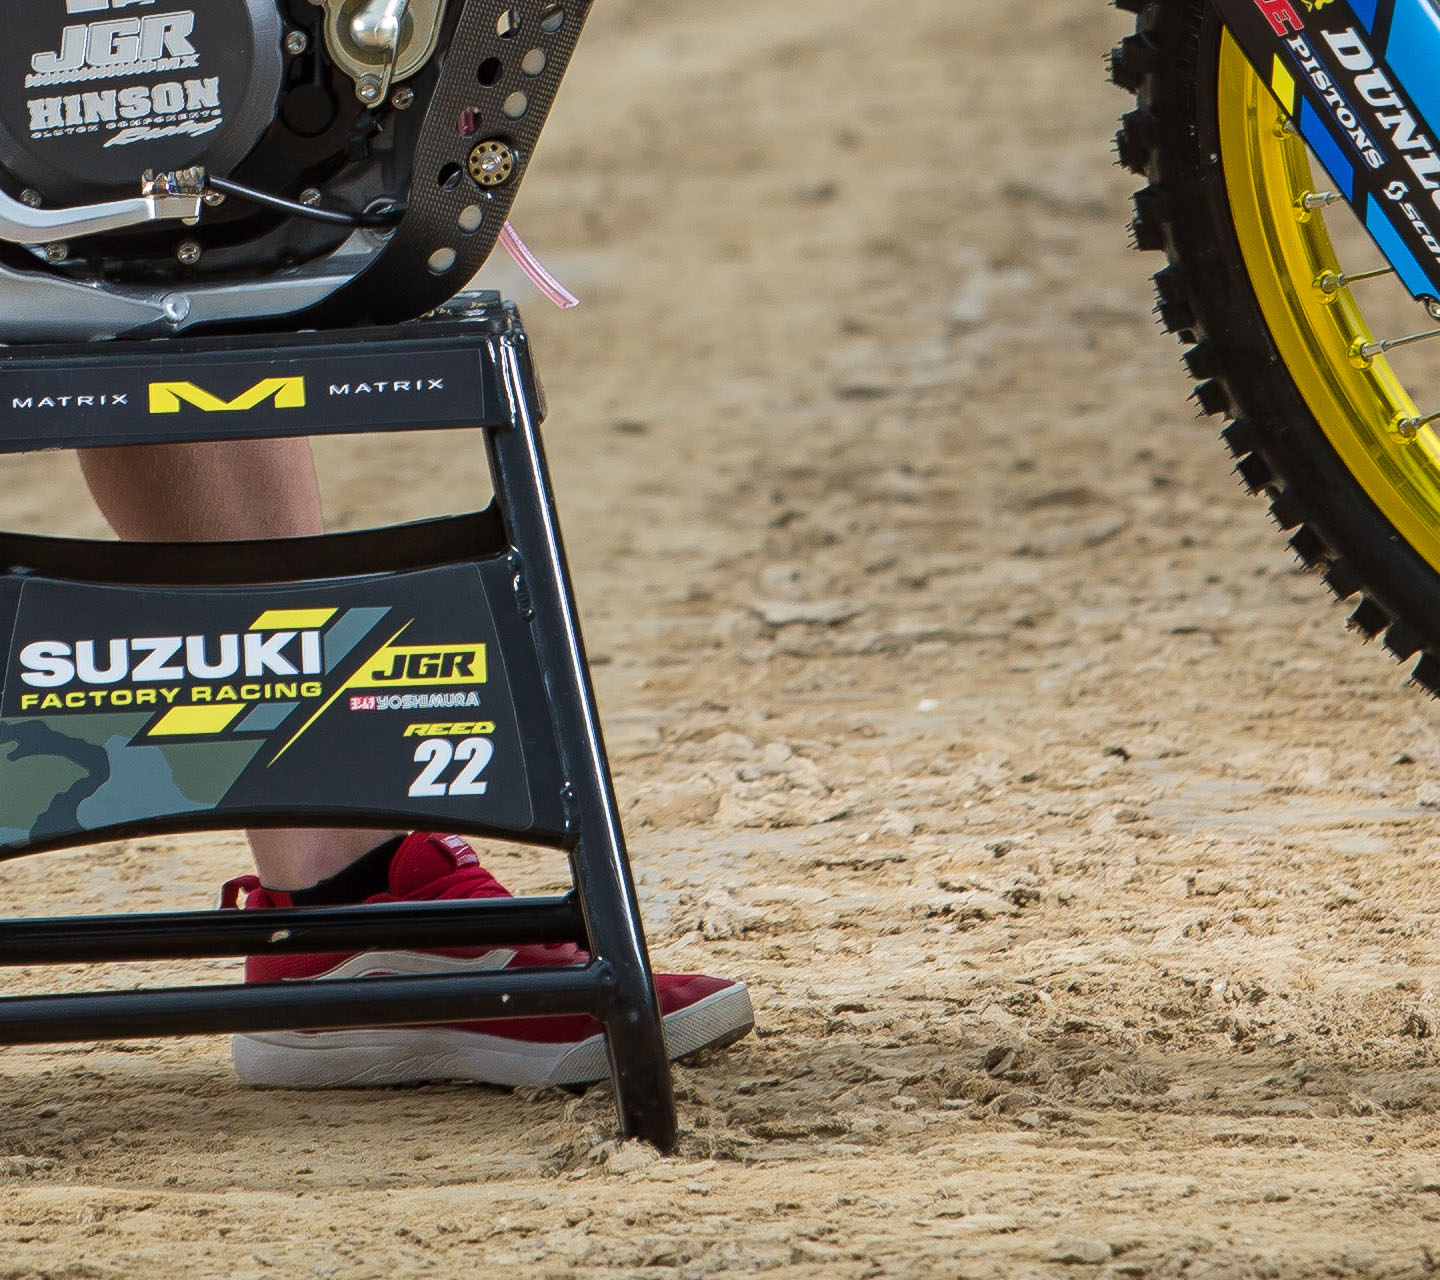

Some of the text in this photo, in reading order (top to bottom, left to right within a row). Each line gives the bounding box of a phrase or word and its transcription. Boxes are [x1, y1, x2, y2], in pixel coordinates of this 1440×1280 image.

[31, 10, 197, 73] JGR
[27, 76, 220, 130] HINSON
[1287, 34, 1385, 169] PISTONS
[12, 393, 128, 408] MATRIX
[329, 378, 445, 395] MATRIX
[20, 630, 321, 688] SUZUKI
[371, 653, 476, 683] JGR
[21, 682, 322, 710] FACTORY RACING
[376, 691, 481, 710] YOSHIMURA
[403, 721, 497, 737] REED
[408, 737, 495, 797] 22
